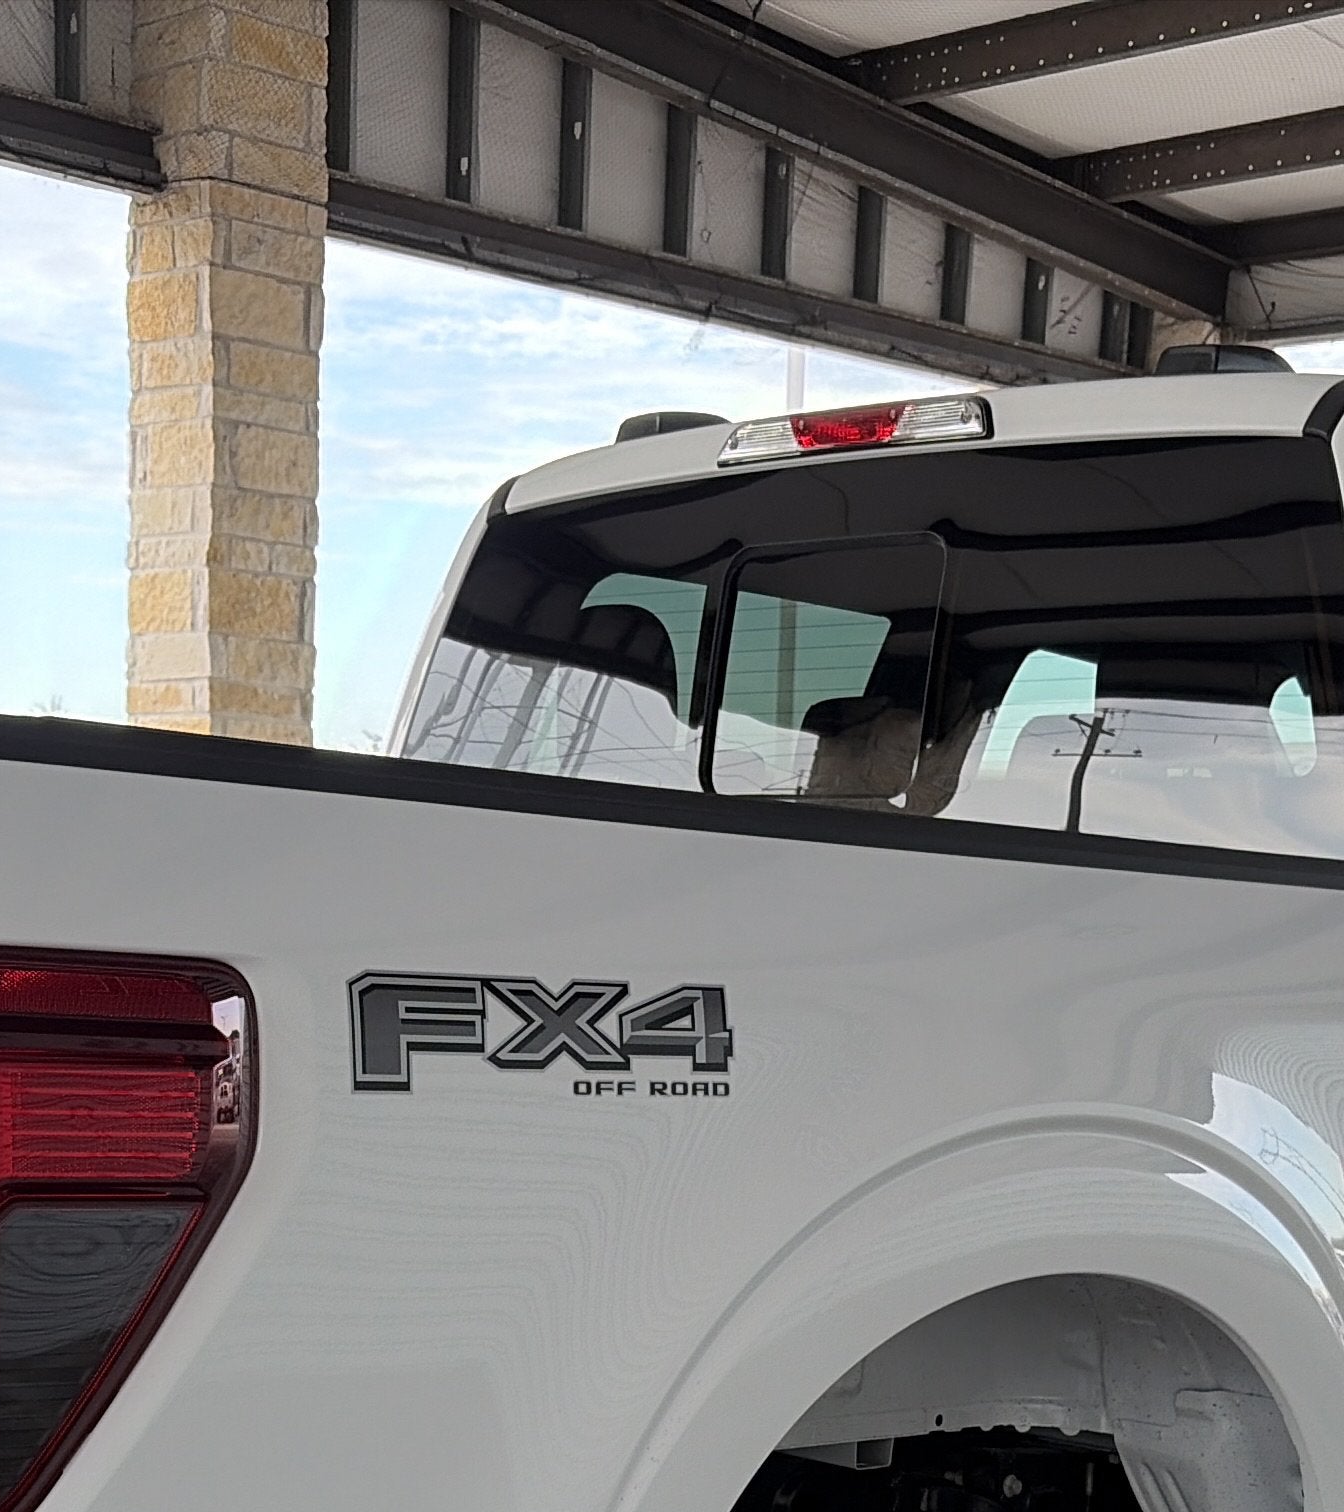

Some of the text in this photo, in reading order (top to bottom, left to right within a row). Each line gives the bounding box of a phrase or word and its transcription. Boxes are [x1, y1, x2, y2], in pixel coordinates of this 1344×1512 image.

[346, 969, 734, 1095] FX4
[573, 1080, 731, 1098] OFF ROAD
